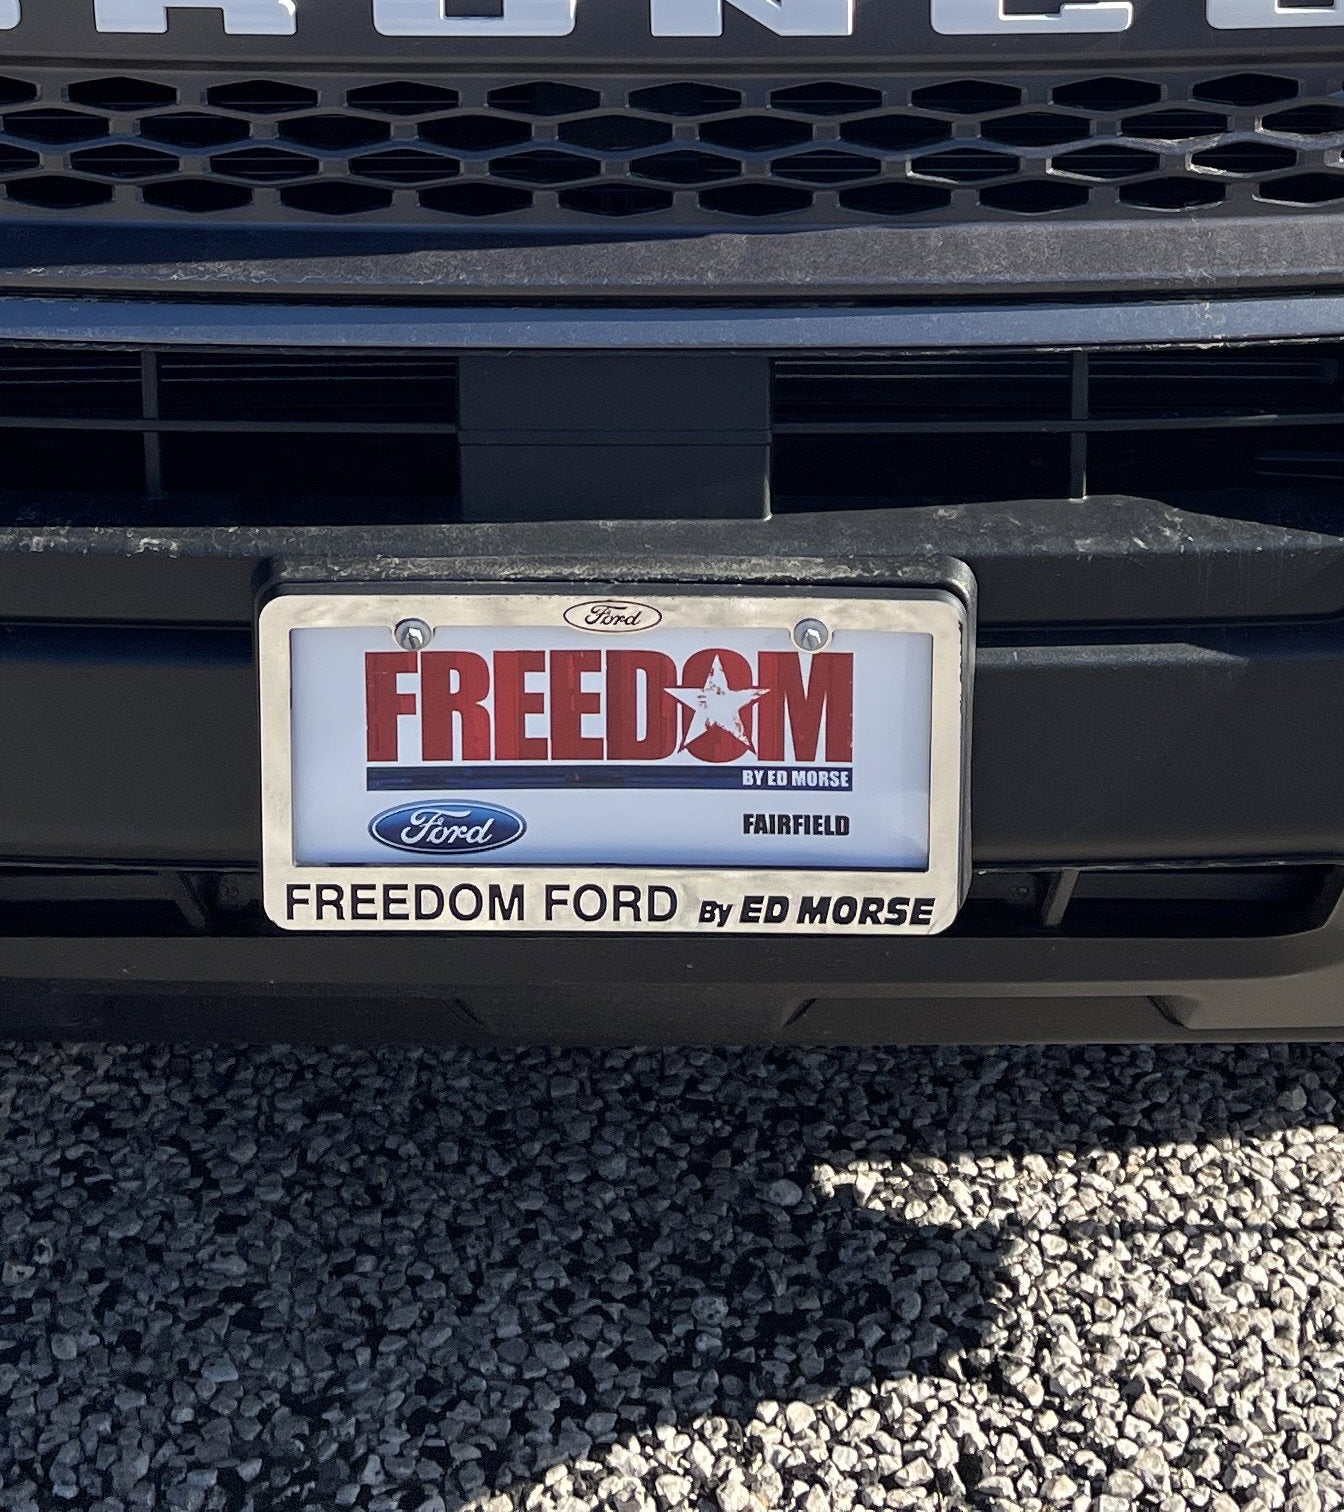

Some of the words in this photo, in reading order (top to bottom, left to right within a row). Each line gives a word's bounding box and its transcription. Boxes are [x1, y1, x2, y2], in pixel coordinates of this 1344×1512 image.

[585, 605, 642, 626] Ford
[365, 648, 854, 763] FREEDOM
[742, 770, 764, 786] BY
[767, 770, 788, 786] ED
[791, 770, 849, 788] MORSE
[401, 808, 495, 844] Ford
[743, 813, 850, 836] FAIRFIELD
[286, 883, 525, 923] FREEDOM
[544, 884, 679, 923] FORD
[699, 900, 733, 927] By
[739, 895, 791, 924] ED
[797, 895, 936, 926] MORSE
